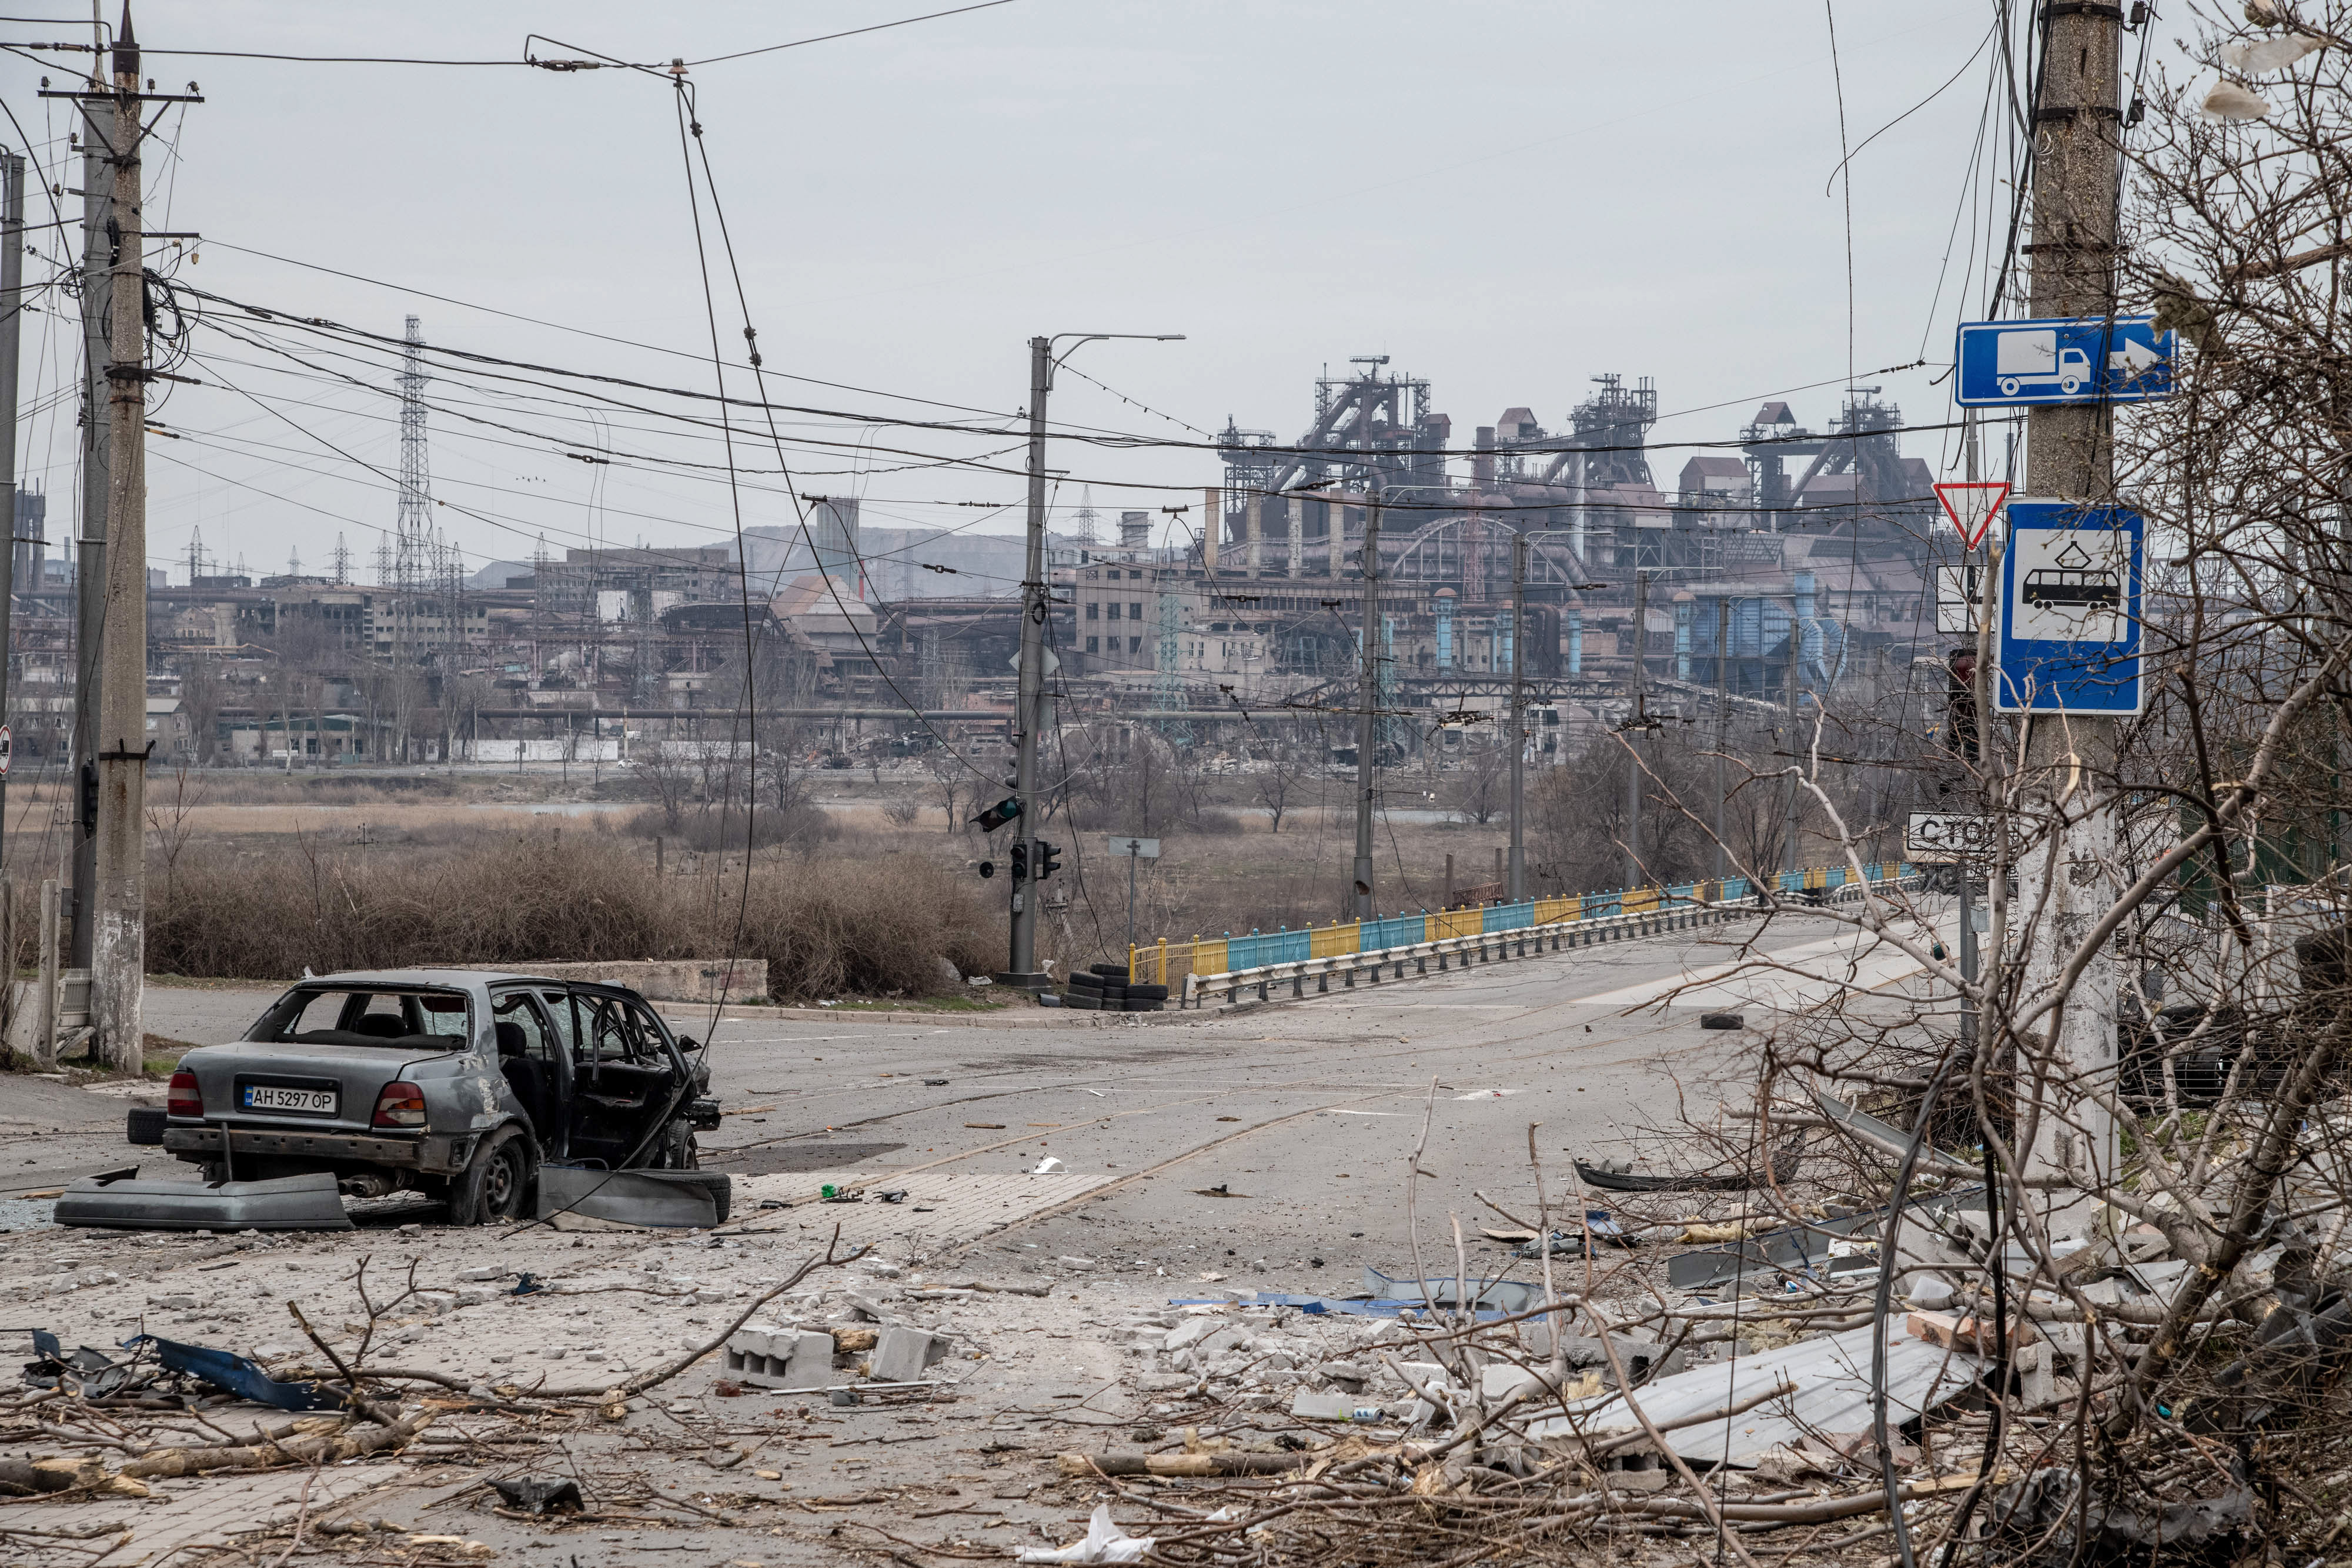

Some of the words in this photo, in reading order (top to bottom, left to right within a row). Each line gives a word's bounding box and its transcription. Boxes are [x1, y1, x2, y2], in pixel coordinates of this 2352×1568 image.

[253, 1089, 273, 1105] AH
[277, 1091, 309, 1107] 5297
[312, 1094, 332, 1109] OP
